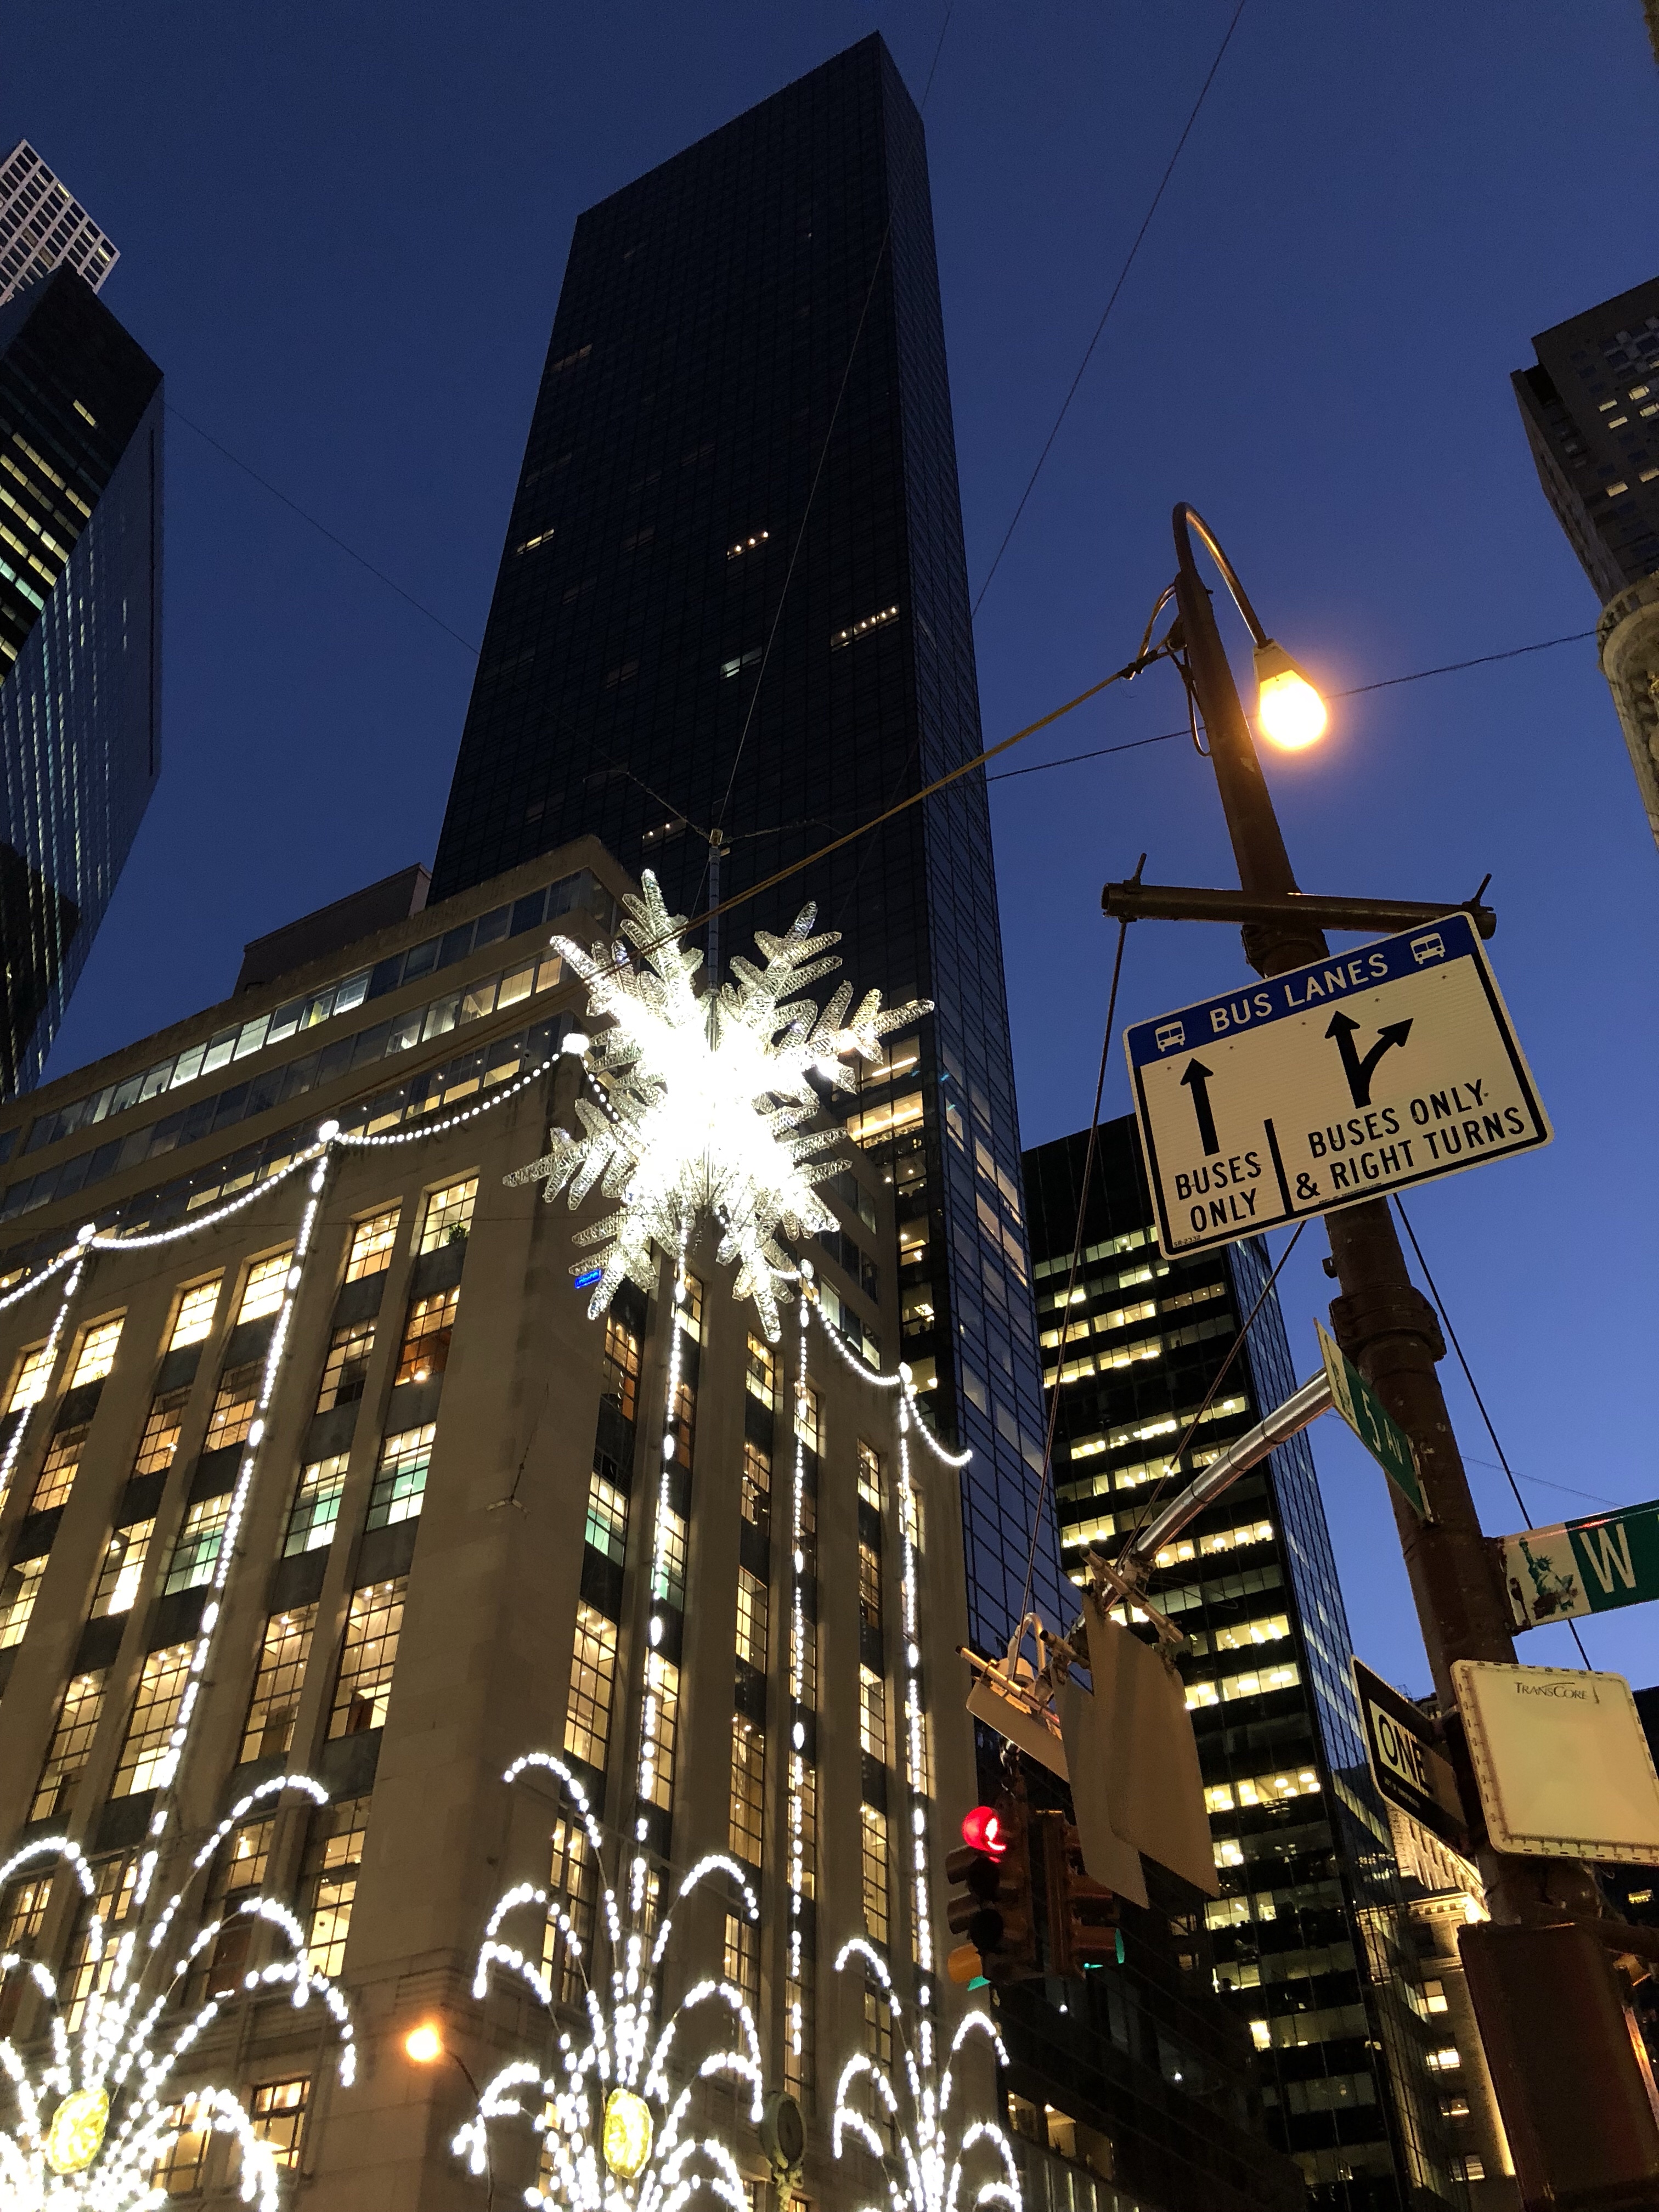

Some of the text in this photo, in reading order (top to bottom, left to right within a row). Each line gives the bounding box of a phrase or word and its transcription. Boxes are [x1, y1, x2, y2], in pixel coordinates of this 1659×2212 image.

[1210, 953, 1388, 1033] BUS LANES
[1296, 1107, 1525, 1200] & RIGHT TURNS
[1308, 1079, 1483, 1159] BUSES ONLY
[1175, 1152, 1261, 1200] BUSES
[1190, 1188, 1256, 1232] ONLY
[1361, 1387, 1381, 1452] 5
[1579, 1523, 1637, 1593] W
[1379, 1714, 1434, 1795] ONE
